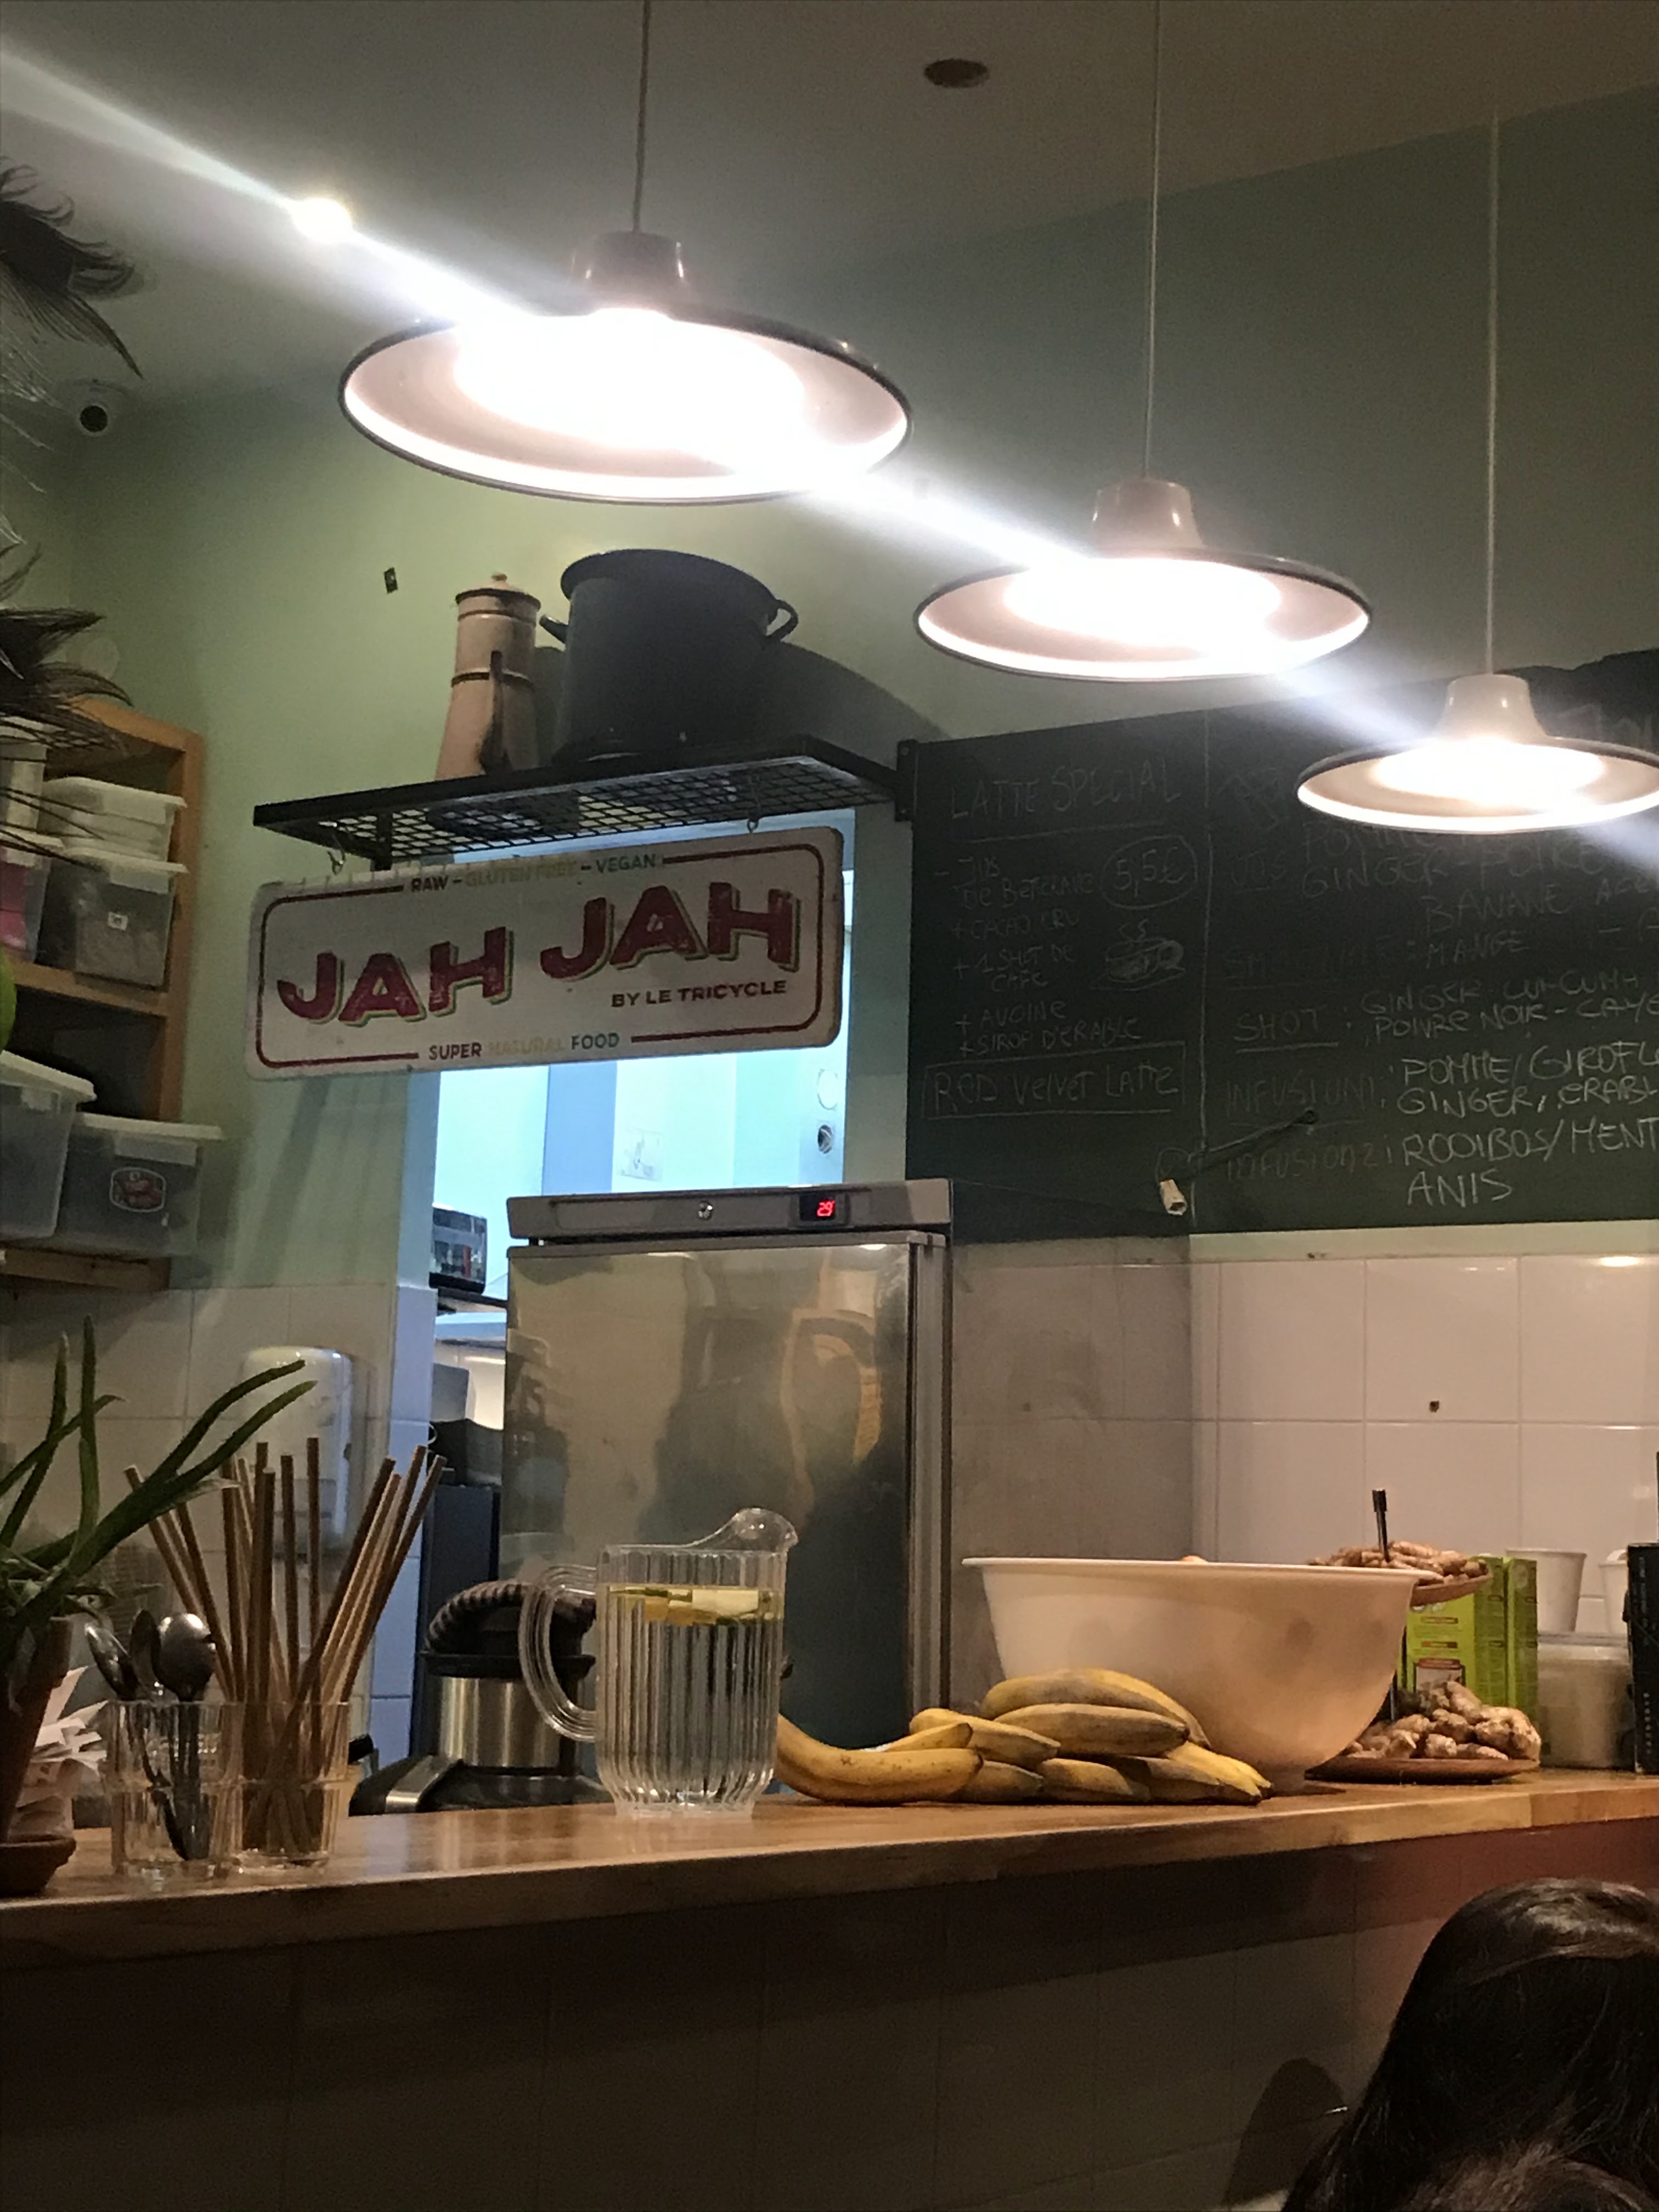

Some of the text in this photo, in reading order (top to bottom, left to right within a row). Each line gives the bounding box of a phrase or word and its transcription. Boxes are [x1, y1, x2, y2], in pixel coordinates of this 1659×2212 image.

[950, 776, 1041, 819] LATTE
[410, 877, 448, 893] RAW
[595, 852, 657, 874] VEGAN
[277, 881, 802, 1028] JAH JAH
[611, 979, 787, 1008] BY LE TRICYCLE
[1233, 1003, 1330, 1042] SHOT
[428, 1042, 482, 1061] SUPER
[571, 1032, 620, 1051] FOOD
[1407, 1167, 1513, 1208] ANIS
